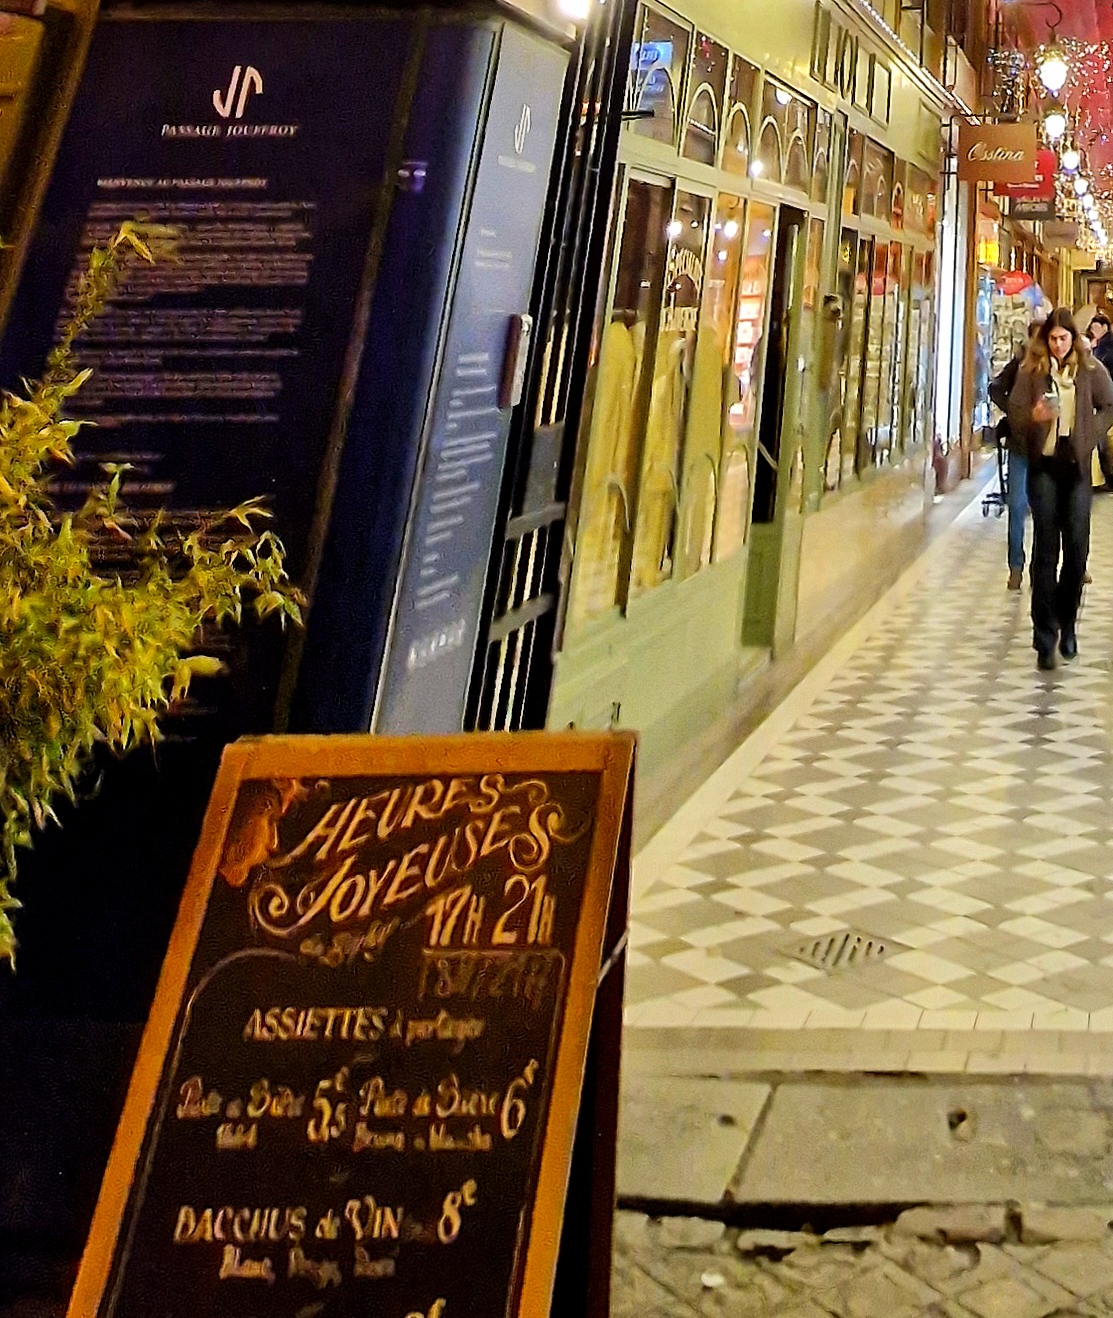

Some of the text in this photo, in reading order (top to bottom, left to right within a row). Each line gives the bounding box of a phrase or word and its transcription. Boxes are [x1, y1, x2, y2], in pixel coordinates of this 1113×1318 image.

[270, 773, 506, 867] HEURES
[250, 802, 590, 936] JOYEUSES
[243, 1006, 388, 1041] ASSIETTES
